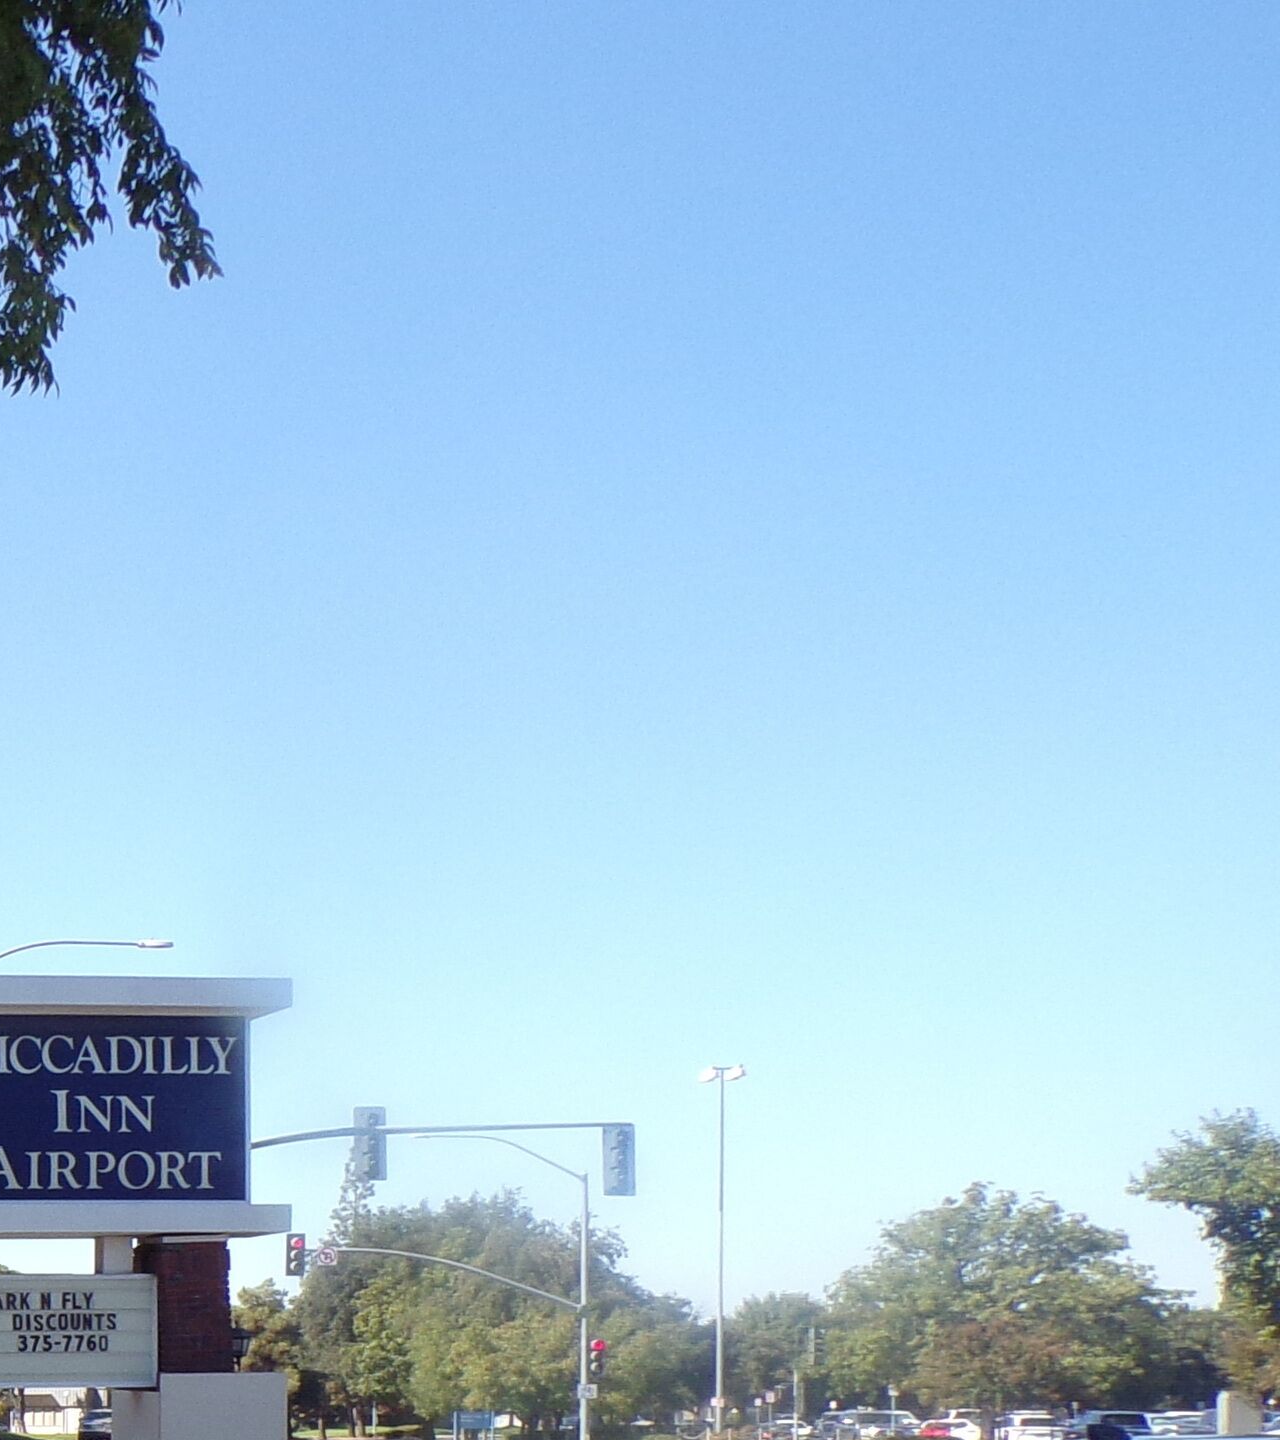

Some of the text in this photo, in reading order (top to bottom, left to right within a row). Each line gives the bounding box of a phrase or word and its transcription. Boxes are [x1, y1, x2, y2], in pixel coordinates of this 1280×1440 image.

[49, 1089, 156, 1133] INN
[40, 1292, 52, 1310] N
[61, 1292, 94, 1310] FLY
[11, 1313, 118, 1331] DISCOUNTS
[17, 1334, 109, 1352] 375-7760
